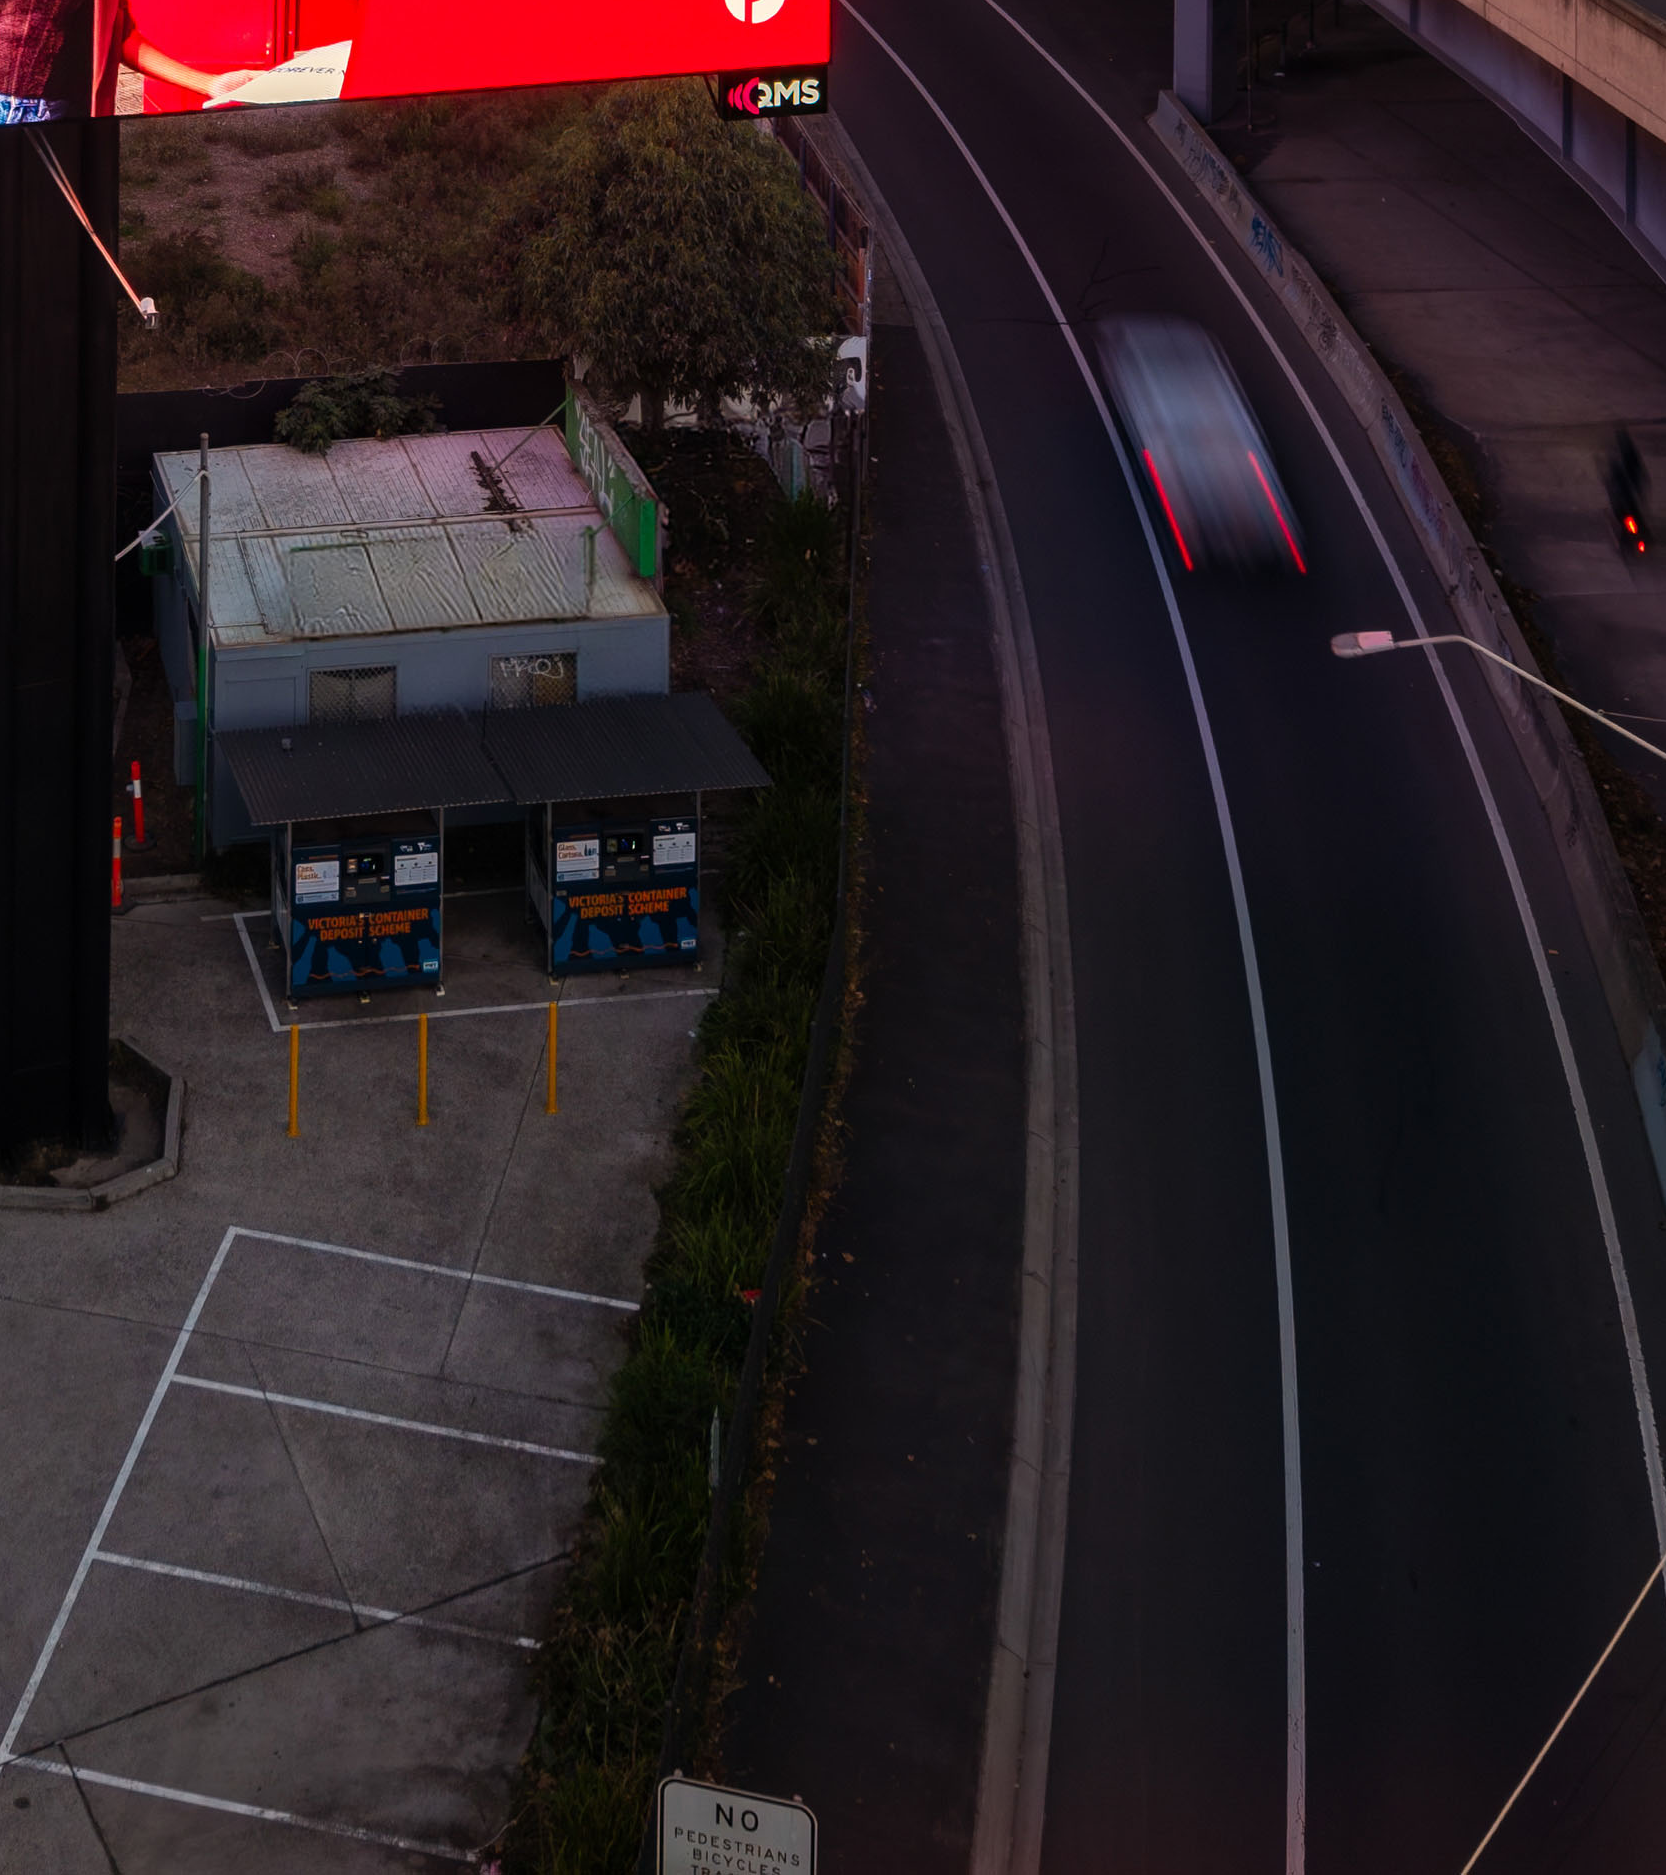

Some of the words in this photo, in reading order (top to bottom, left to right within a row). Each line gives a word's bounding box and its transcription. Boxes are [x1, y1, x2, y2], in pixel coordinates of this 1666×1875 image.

[742, 77, 820, 115] QMS
[568, 893, 624, 909] VICTORIA'S
[628, 886, 688, 902] CONTAINER
[580, 905, 624, 920] DEPOSIT
[628, 900, 669, 916] SCHEME
[308, 914, 365, 931] VICTORIA'S
[368, 907, 429, 924] CONTAINER
[320, 926, 365, 941] DEPOSIT
[368, 922, 412, 937] SCHEME
[715, 1802, 759, 1833] NO
[673, 1826, 800, 1867] PEDESTRIANS
[692, 1847, 781, 1875] BICYCLES
